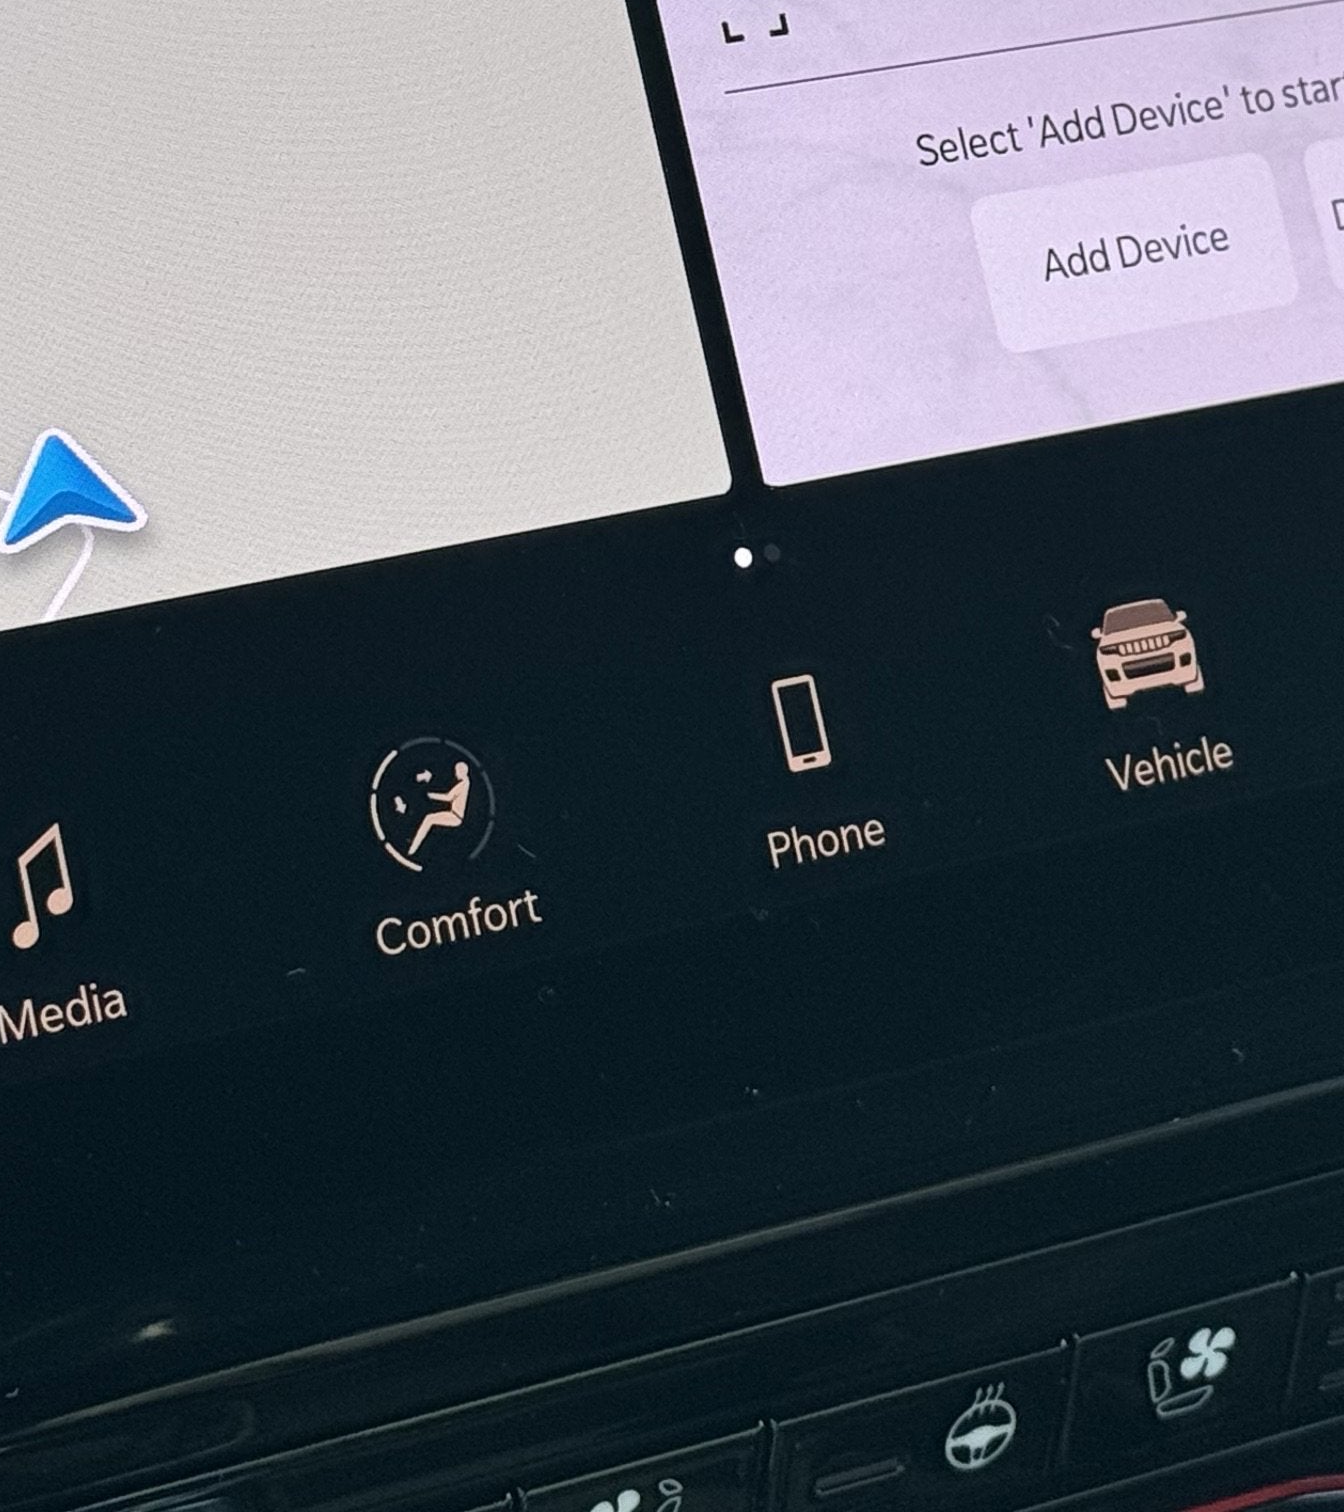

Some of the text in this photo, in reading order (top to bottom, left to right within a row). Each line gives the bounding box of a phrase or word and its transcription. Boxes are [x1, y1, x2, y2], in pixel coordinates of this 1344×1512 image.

[915, 120, 1023, 170] Select
[1027, 103, 1107, 149] 'Add
[1111, 86, 1232, 138] Device'
[1240, 83, 1276, 115] to
[1042, 221, 1230, 281] Add Device
[1104, 733, 1235, 793] Vehicle
[765, 815, 886, 870] Phone
[375, 888, 543, 957] Comfort
